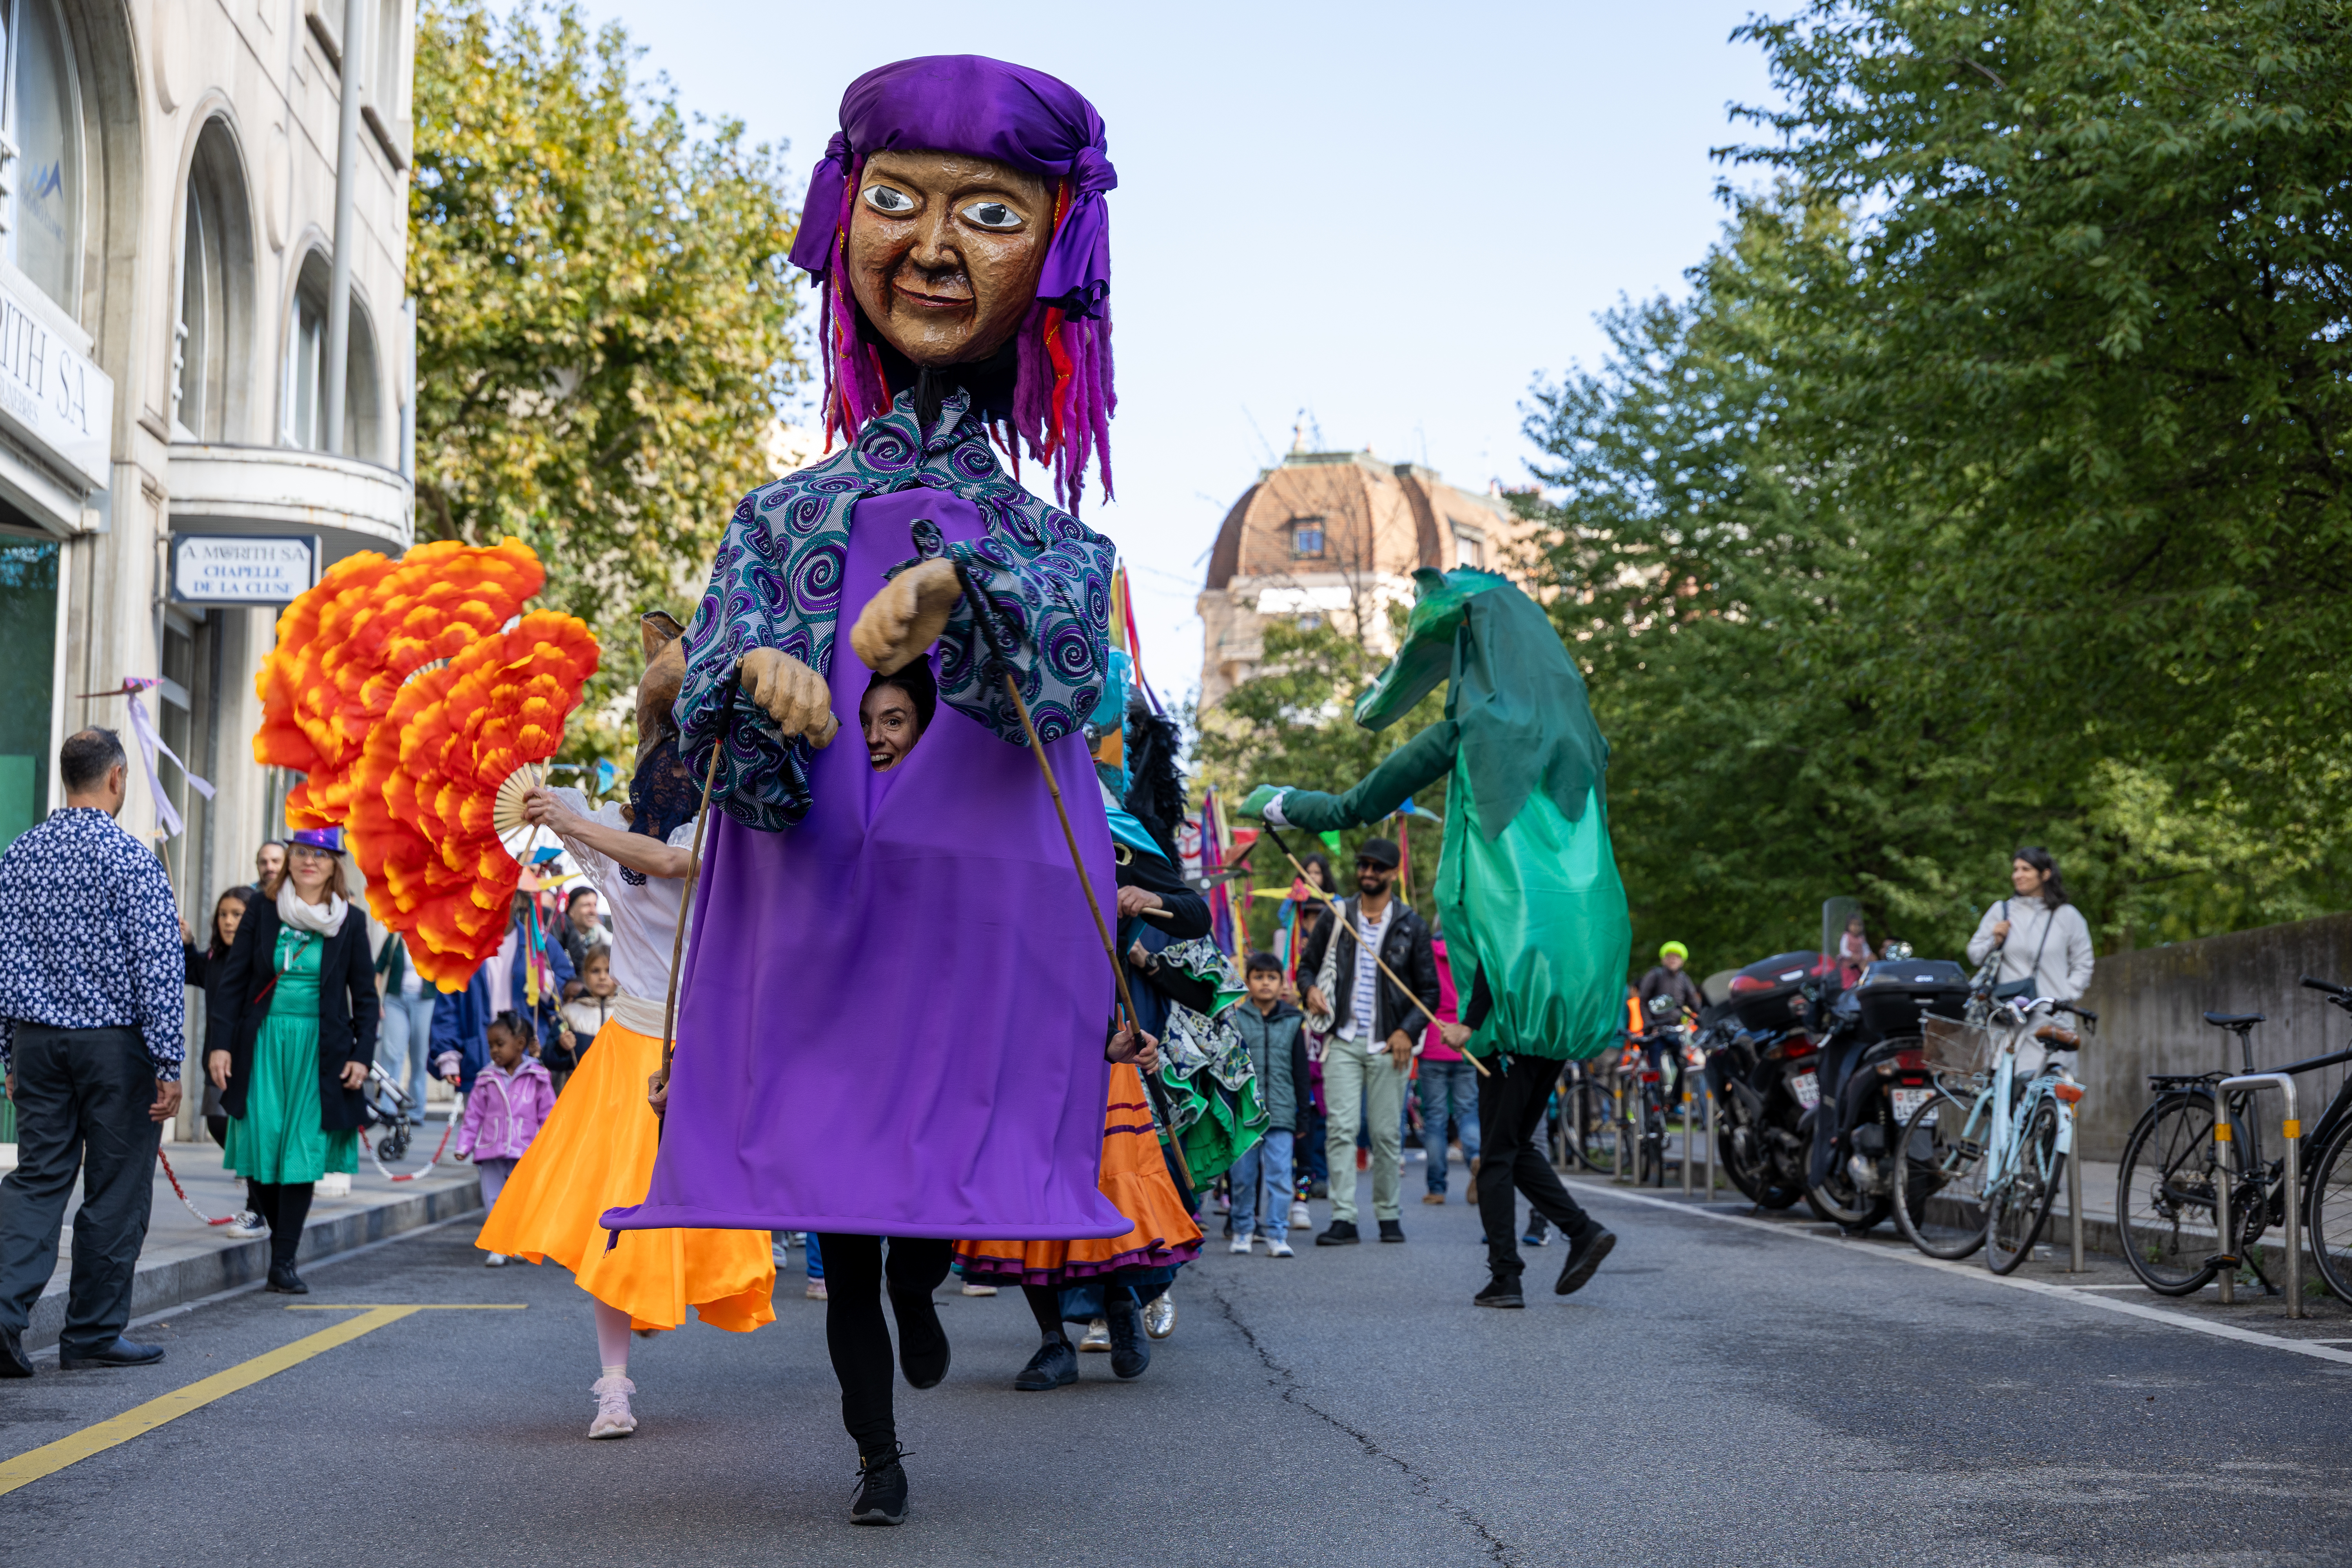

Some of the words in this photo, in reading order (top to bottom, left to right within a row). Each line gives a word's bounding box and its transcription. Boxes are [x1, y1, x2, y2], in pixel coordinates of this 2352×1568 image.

[57, 349, 91, 437] SA
[281, 546, 307, 562] SA
[203, 564, 284, 579] CHAPELLE
[193, 579, 214, 593] DE
[220, 581, 240, 594] LA
[245, 581, 294, 595] CLUSE
